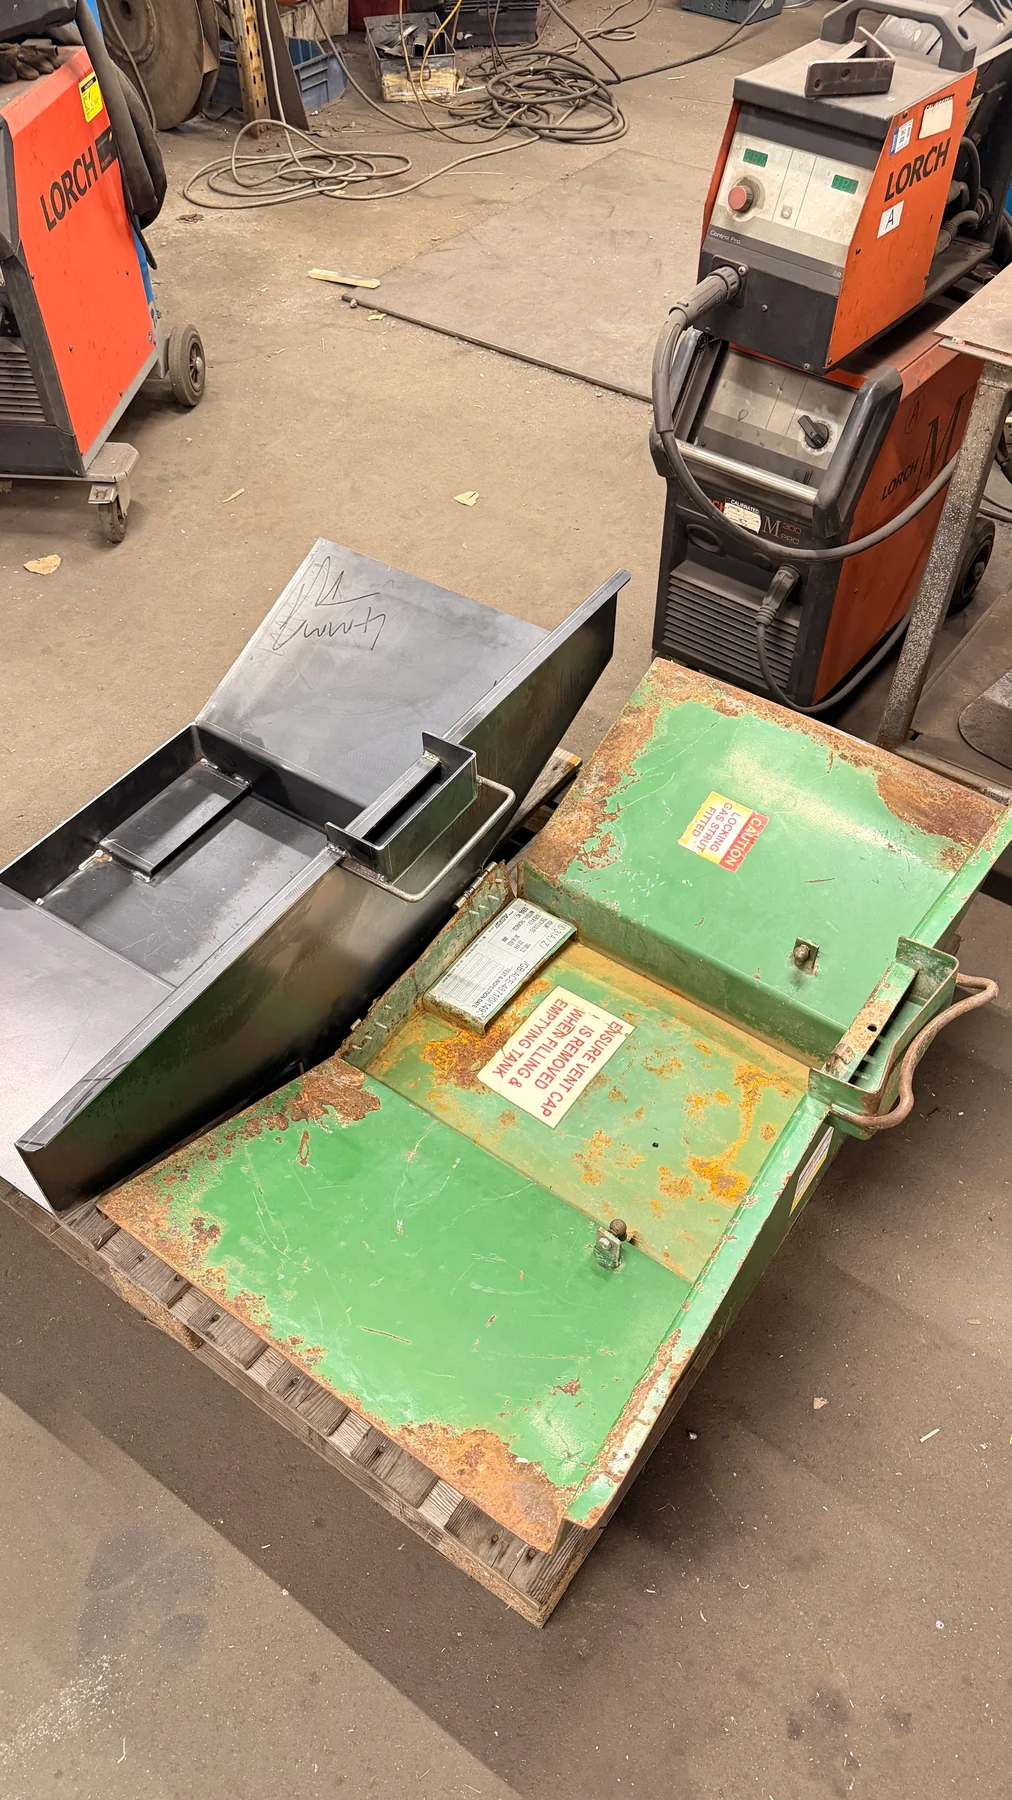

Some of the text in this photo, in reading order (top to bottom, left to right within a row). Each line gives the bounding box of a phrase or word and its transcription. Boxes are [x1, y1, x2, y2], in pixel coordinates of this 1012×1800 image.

[40, 146, 98, 232] LORCH
[884, 137, 951, 202] LORCH
[710, 229, 741, 245] Control Pro
[885, 209, 895, 230] A
[881, 457, 920, 501] LORCH
[762, 515, 782, 538] M
[780, 533, 800, 545] PRO
[782, 522, 802, 535] 300
[692, 806, 717, 837] FITTED
[696, 802, 733, 853] GAS STRUT
[709, 811, 741, 853] LOCKING
[723, 817, 762, 867] CAUTION
[518, 998, 569, 1049] EMPTYING
[492, 1048, 525, 1079] TANK
[508, 1007, 586, 1088] WHEN FILLING &
[534, 1025, 595, 1090] IS REMOVED
[540, 1021, 624, 1117] ENSURE VENT CAP
